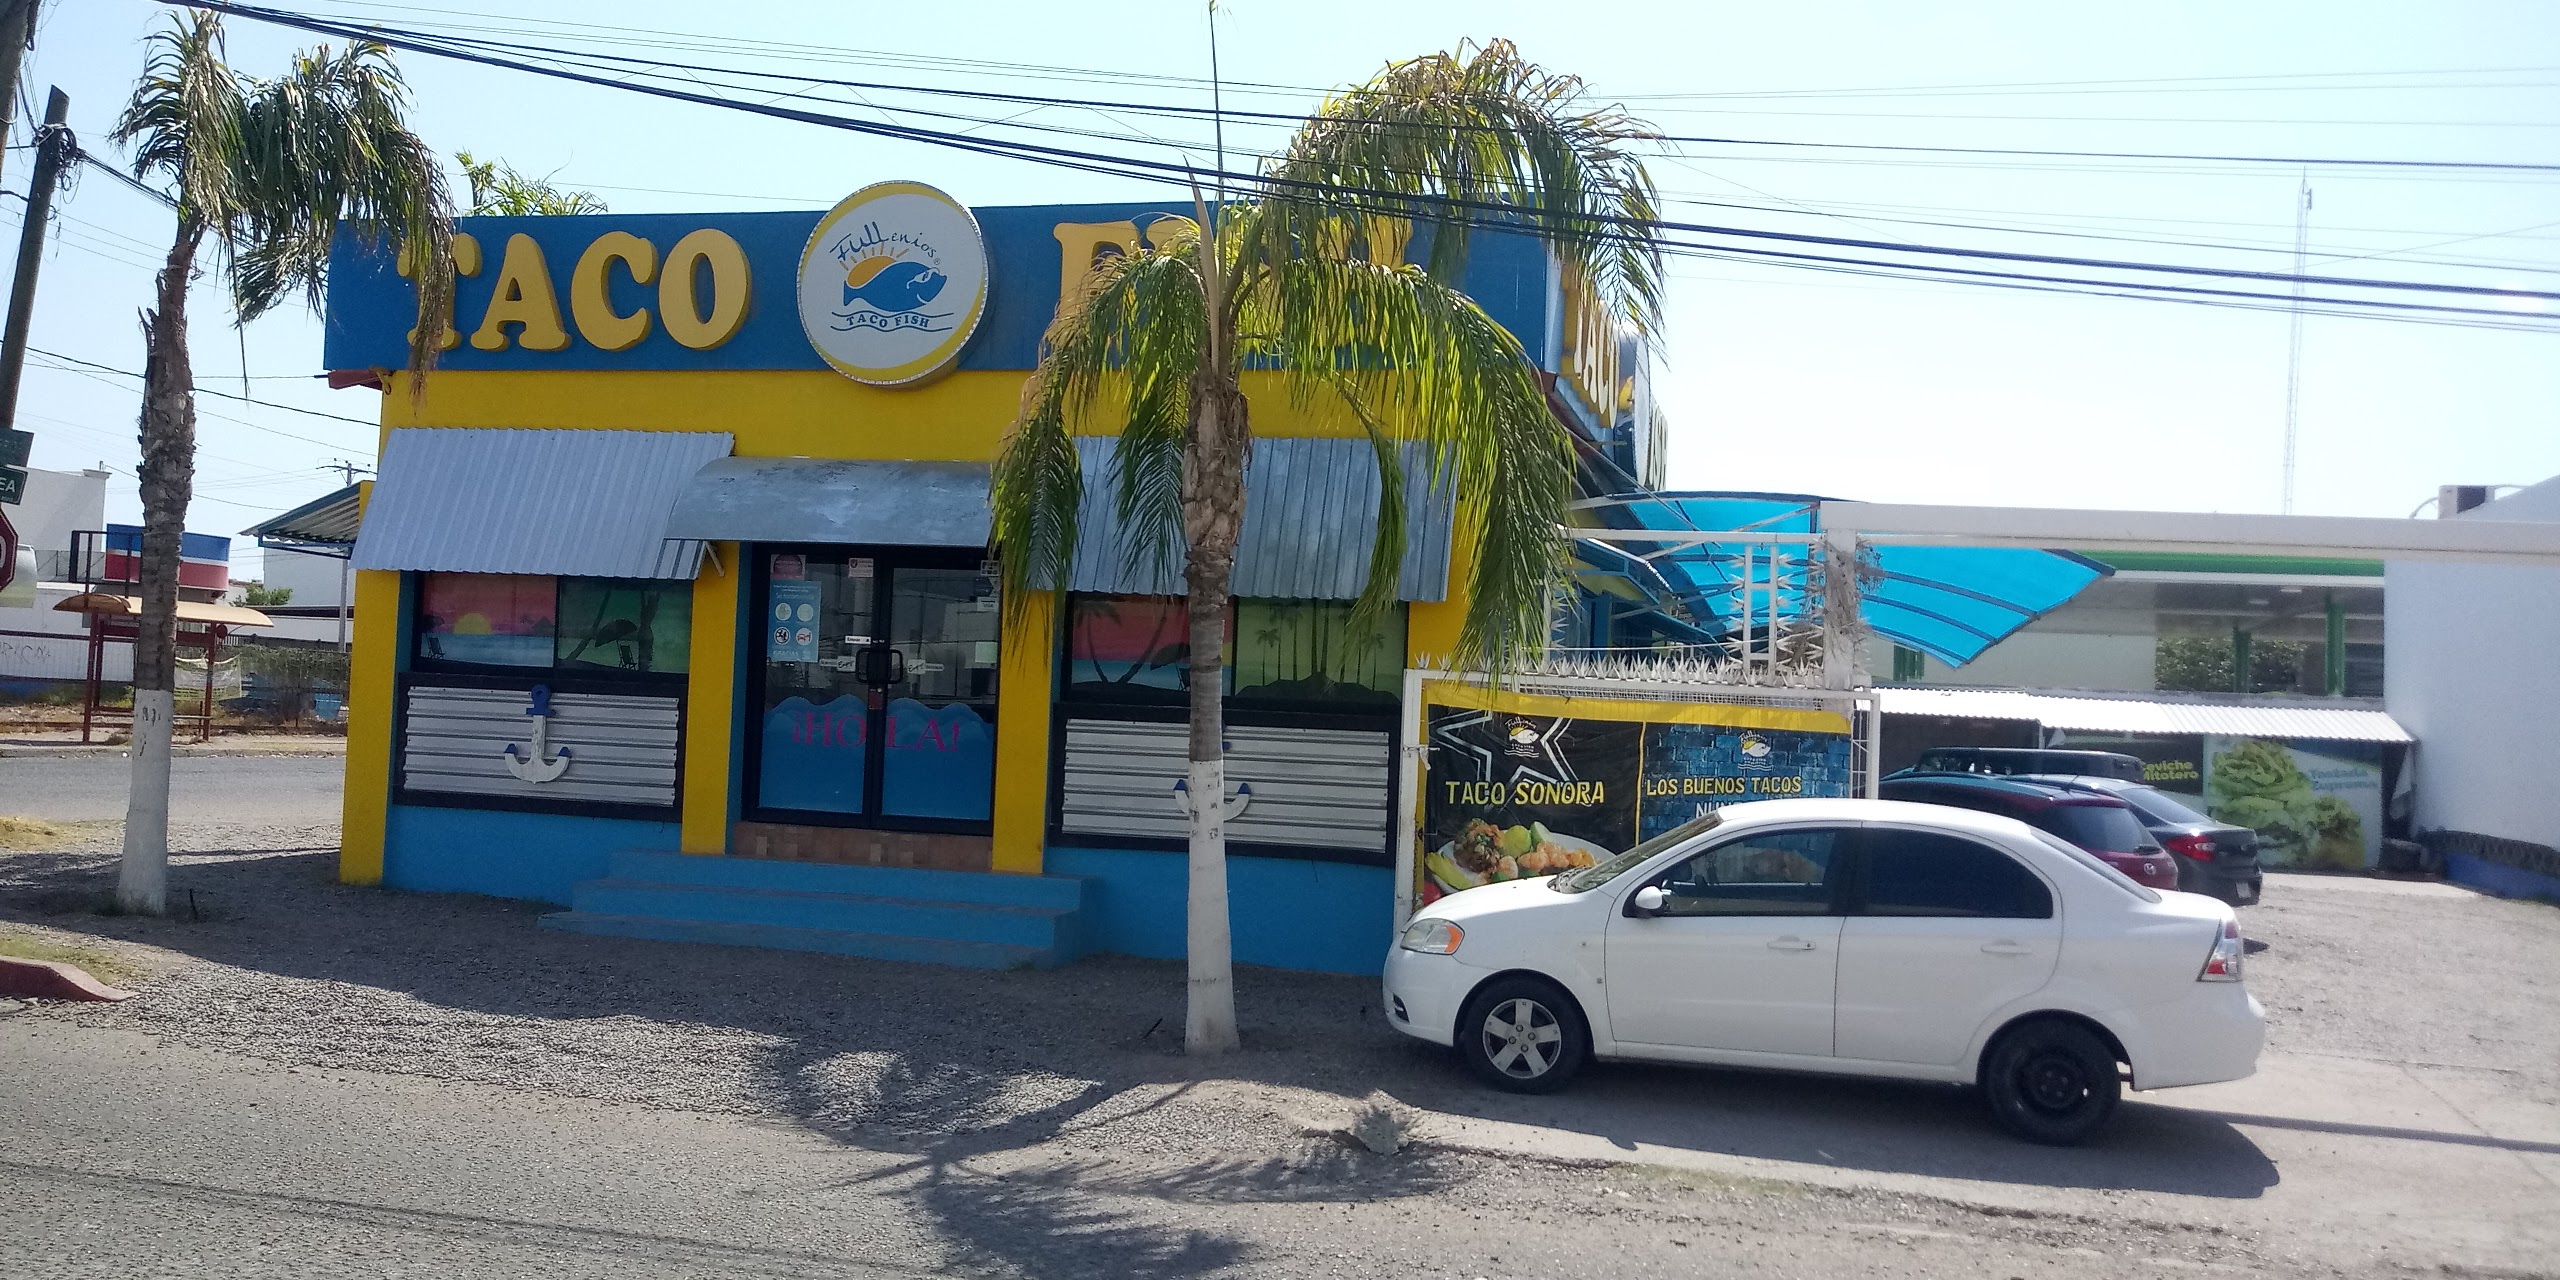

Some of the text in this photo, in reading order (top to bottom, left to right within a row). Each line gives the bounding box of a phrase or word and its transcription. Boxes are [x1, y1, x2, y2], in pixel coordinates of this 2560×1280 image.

[397, 227, 752, 352] TACO
[846, 314, 931, 329] TACO FISH
[1445, 781, 1605, 805] TACO SONORA
[1646, 776, 1802, 796] LOS BUENOS TACOS
